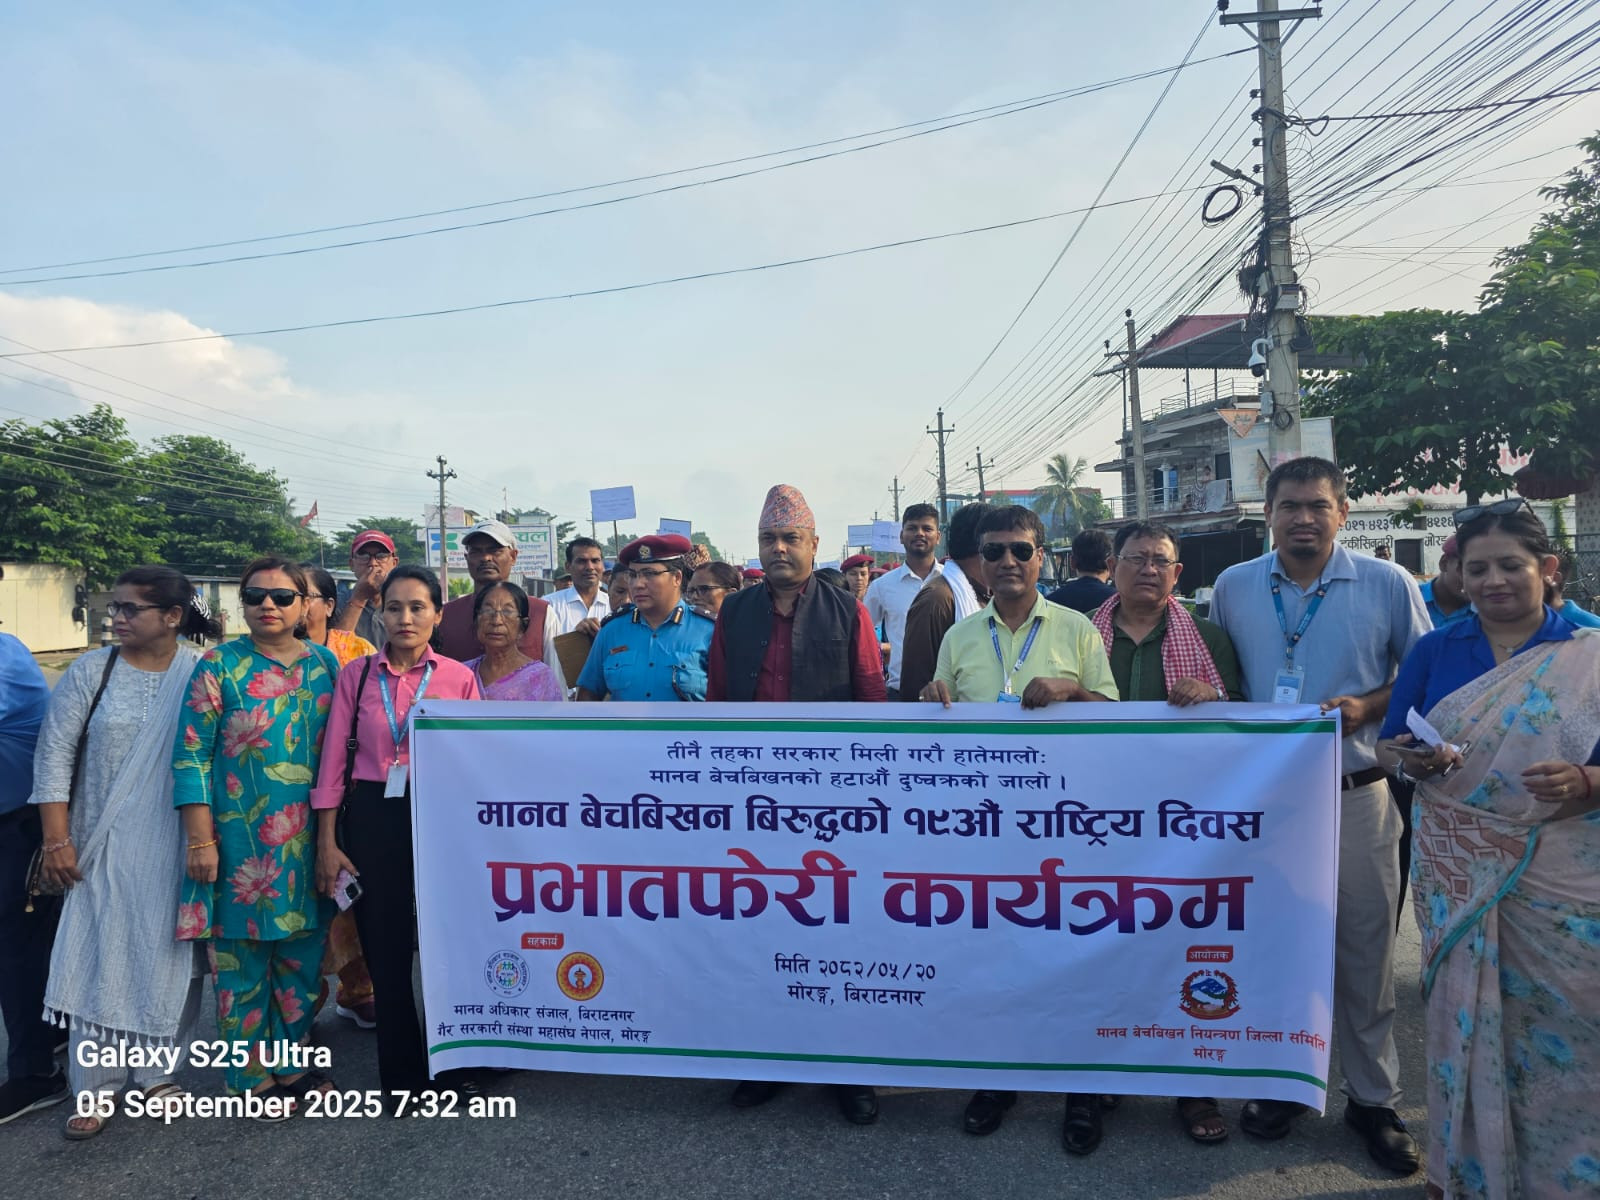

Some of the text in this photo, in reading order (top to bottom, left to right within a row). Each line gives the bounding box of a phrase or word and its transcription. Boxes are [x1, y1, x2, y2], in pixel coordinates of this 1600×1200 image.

[667, 740, 702, 759] तीनै
[710, 746, 763, 763] तहका
[771, 747, 842, 762] सरकार
[850, 743, 899, 762] मिली
[649, 770, 701, 784] मानव
[709, 766, 822, 785] बेचबिखनको
[898, 771, 989, 792] दुष्चक्रको
[998, 771, 1051, 790] जालो
[476, 801, 569, 828] मानव
[580, 793, 734, 831] बेचबिखन
[1016, 800, 1145, 847] राष्ट्रिय
[1157, 799, 1264, 842] दिवस
[486, 848, 1254, 936] प्रभातफेरी कार्यक्रम
[774, 953, 936, 982] मिति २०८२/०५/२०
[844, 982, 926, 1007] बिराटनगर
[453, 1001, 635, 1023] मानव अधिकार संजाल, बिराटनगर
[460, 1020, 504, 1035] सरकारी
[506, 1022, 534, 1037] संस्था
[537, 1025, 576, 1040] महासंघ
[580, 1026, 614, 1043] नेपाल,
[1096, 1028, 1128, 1038] मानव
[1191, 1025, 1241, 1040] नियन्त्रण
[1246, 1026, 1283, 1042] जिल्ला
[1289, 1030, 1326, 1051] समिति
